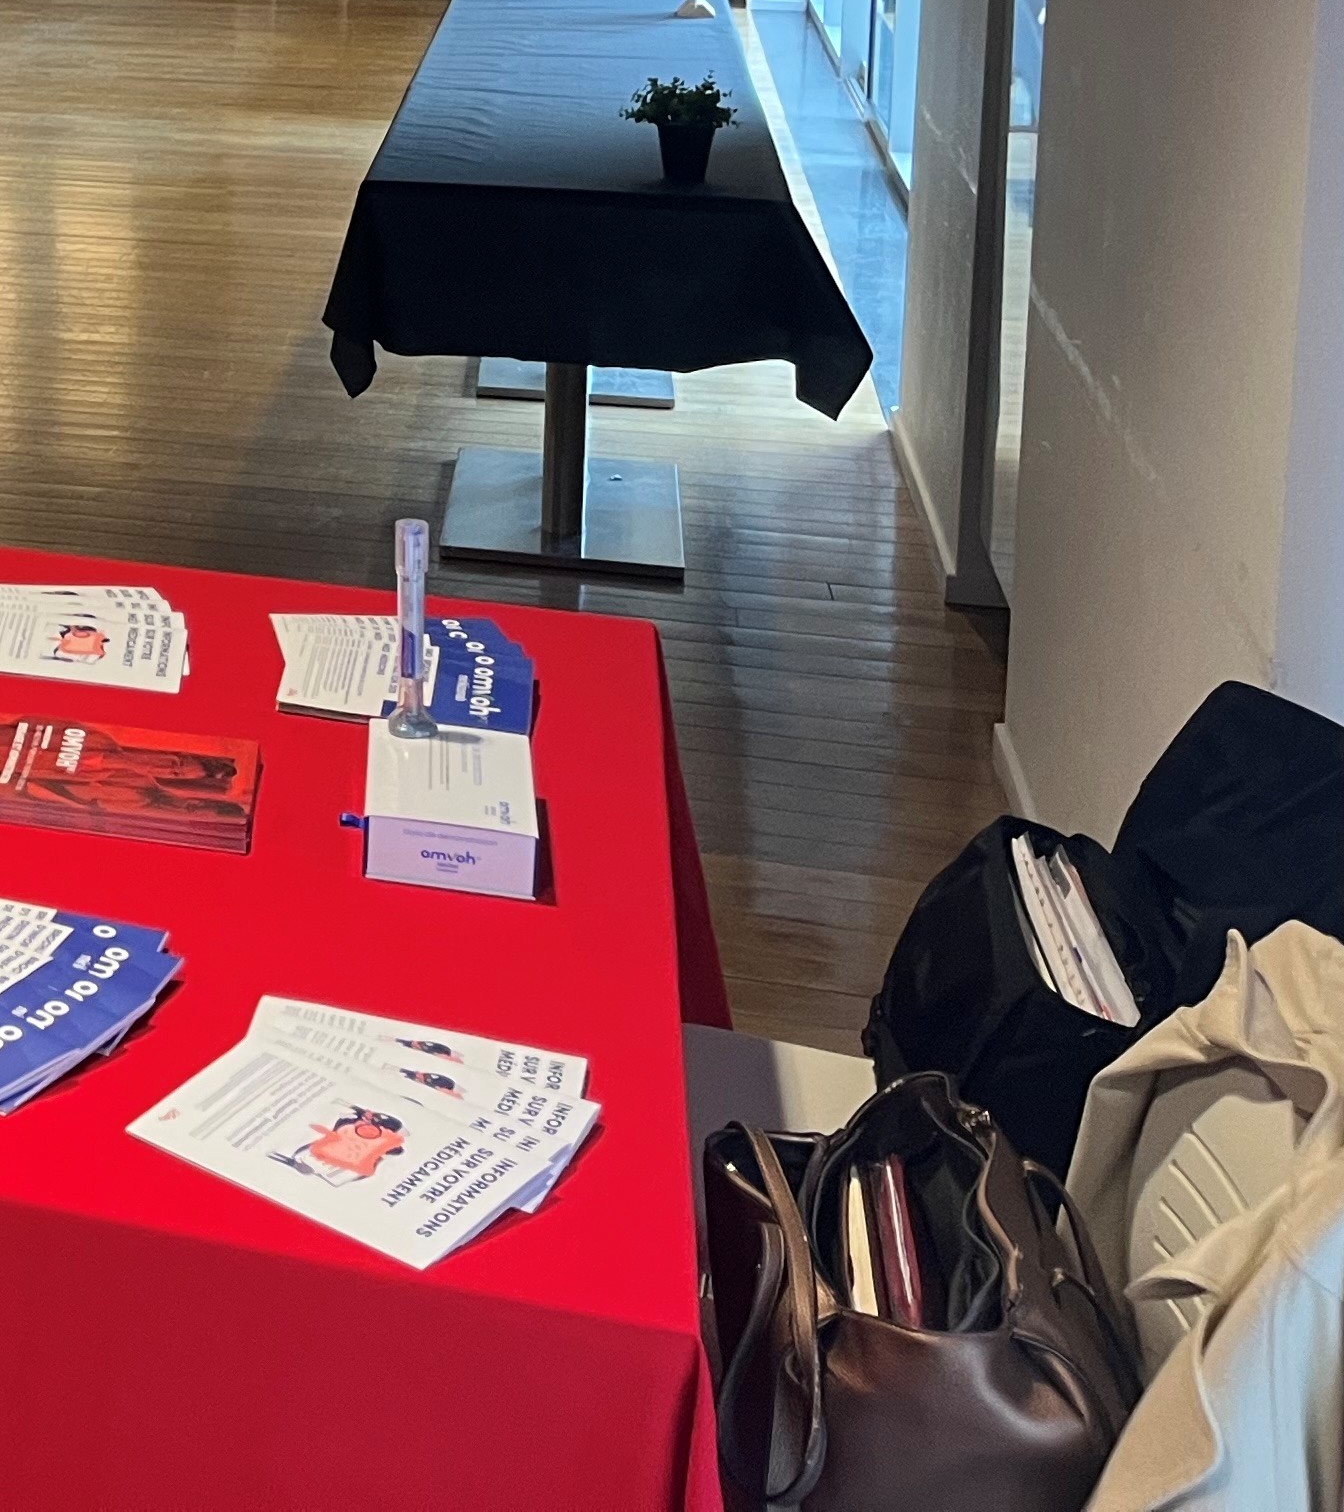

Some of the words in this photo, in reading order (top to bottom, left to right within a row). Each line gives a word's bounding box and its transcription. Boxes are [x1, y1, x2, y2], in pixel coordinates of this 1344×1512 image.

[469, 668, 501, 716] omvoh
[420, 849, 477, 865] omvoh
[381, 1137, 471, 1208] MÉDICAMENT
[461, 1147, 494, 1169] SUR
[416, 1157, 518, 1238] INFORMATIONS
[419, 1168, 470, 1204] VOTRE
